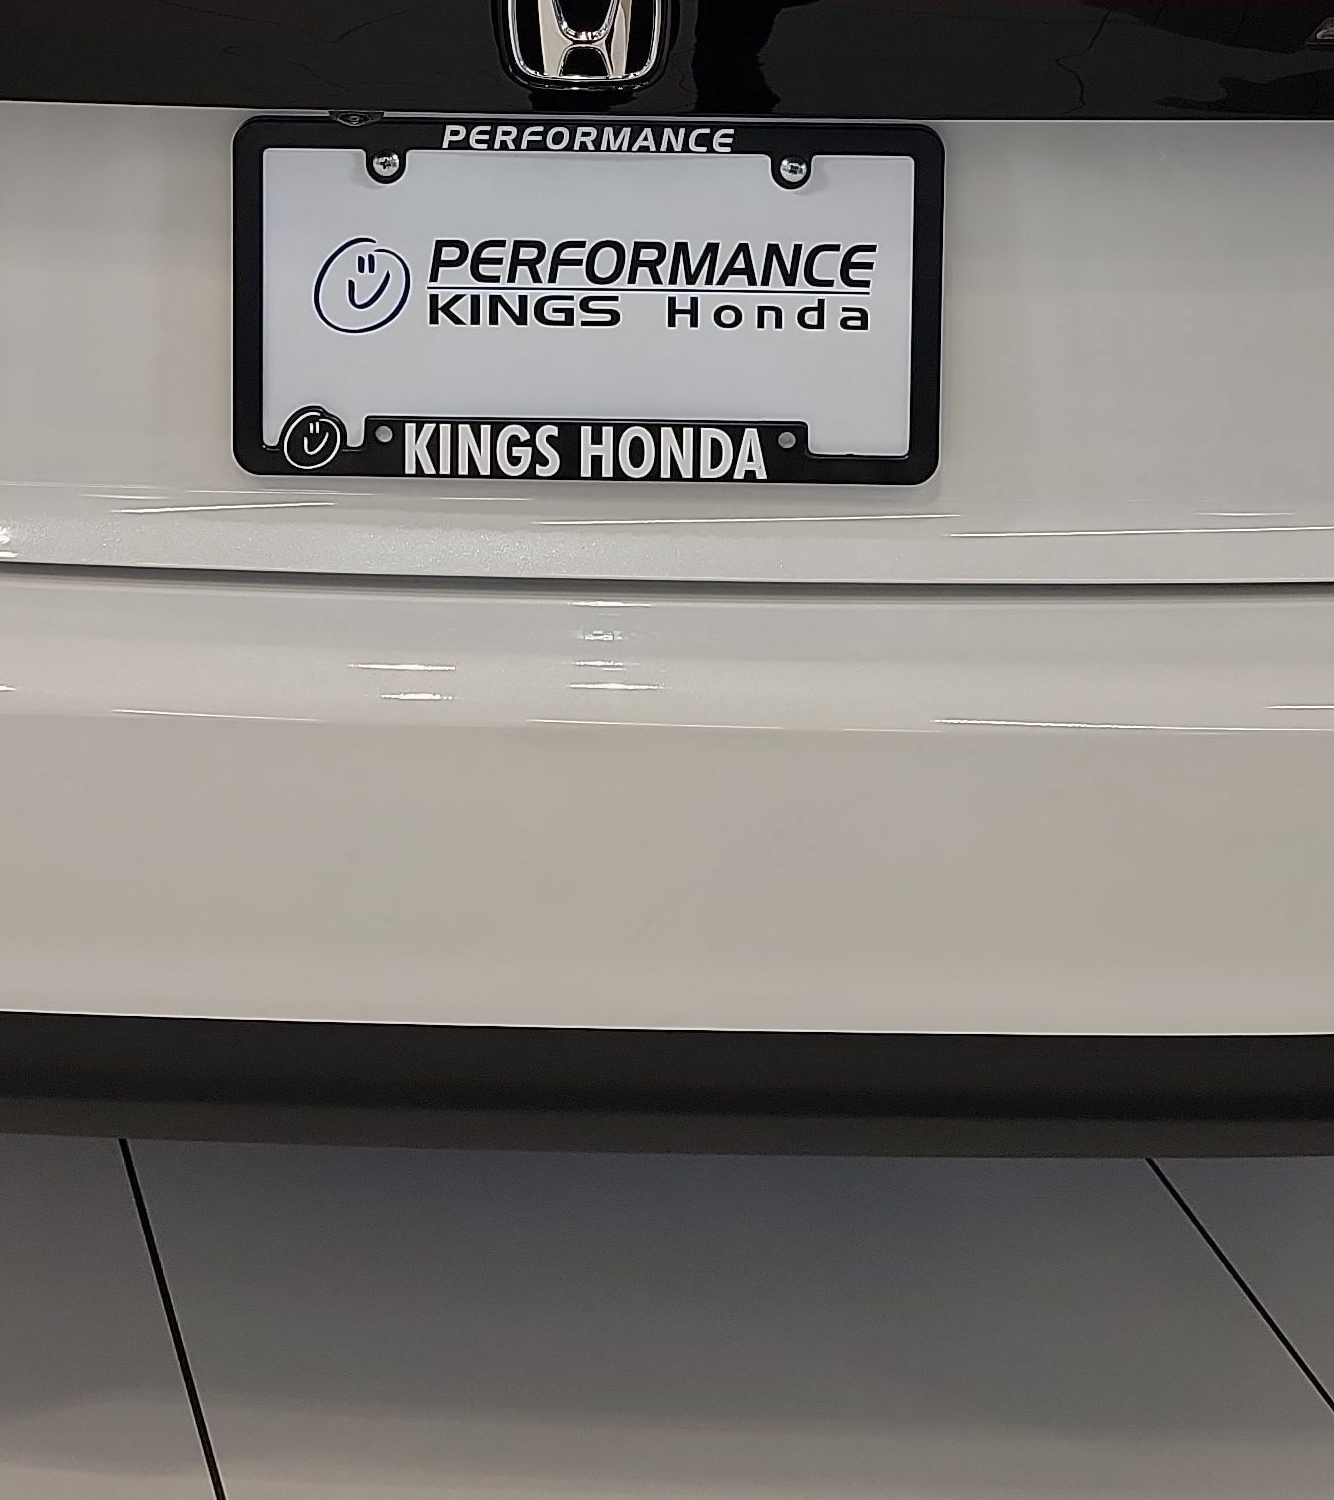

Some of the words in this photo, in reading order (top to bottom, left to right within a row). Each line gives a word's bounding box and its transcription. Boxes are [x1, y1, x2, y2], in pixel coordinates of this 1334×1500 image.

[441, 125, 735, 153] PERFORMANCE
[428, 239, 878, 289] PERFORMANCE
[427, 294, 622, 327] KINGS
[667, 296, 869, 331] Honda
[404, 422, 562, 477] KINGS
[580, 427, 768, 480] HONDA
